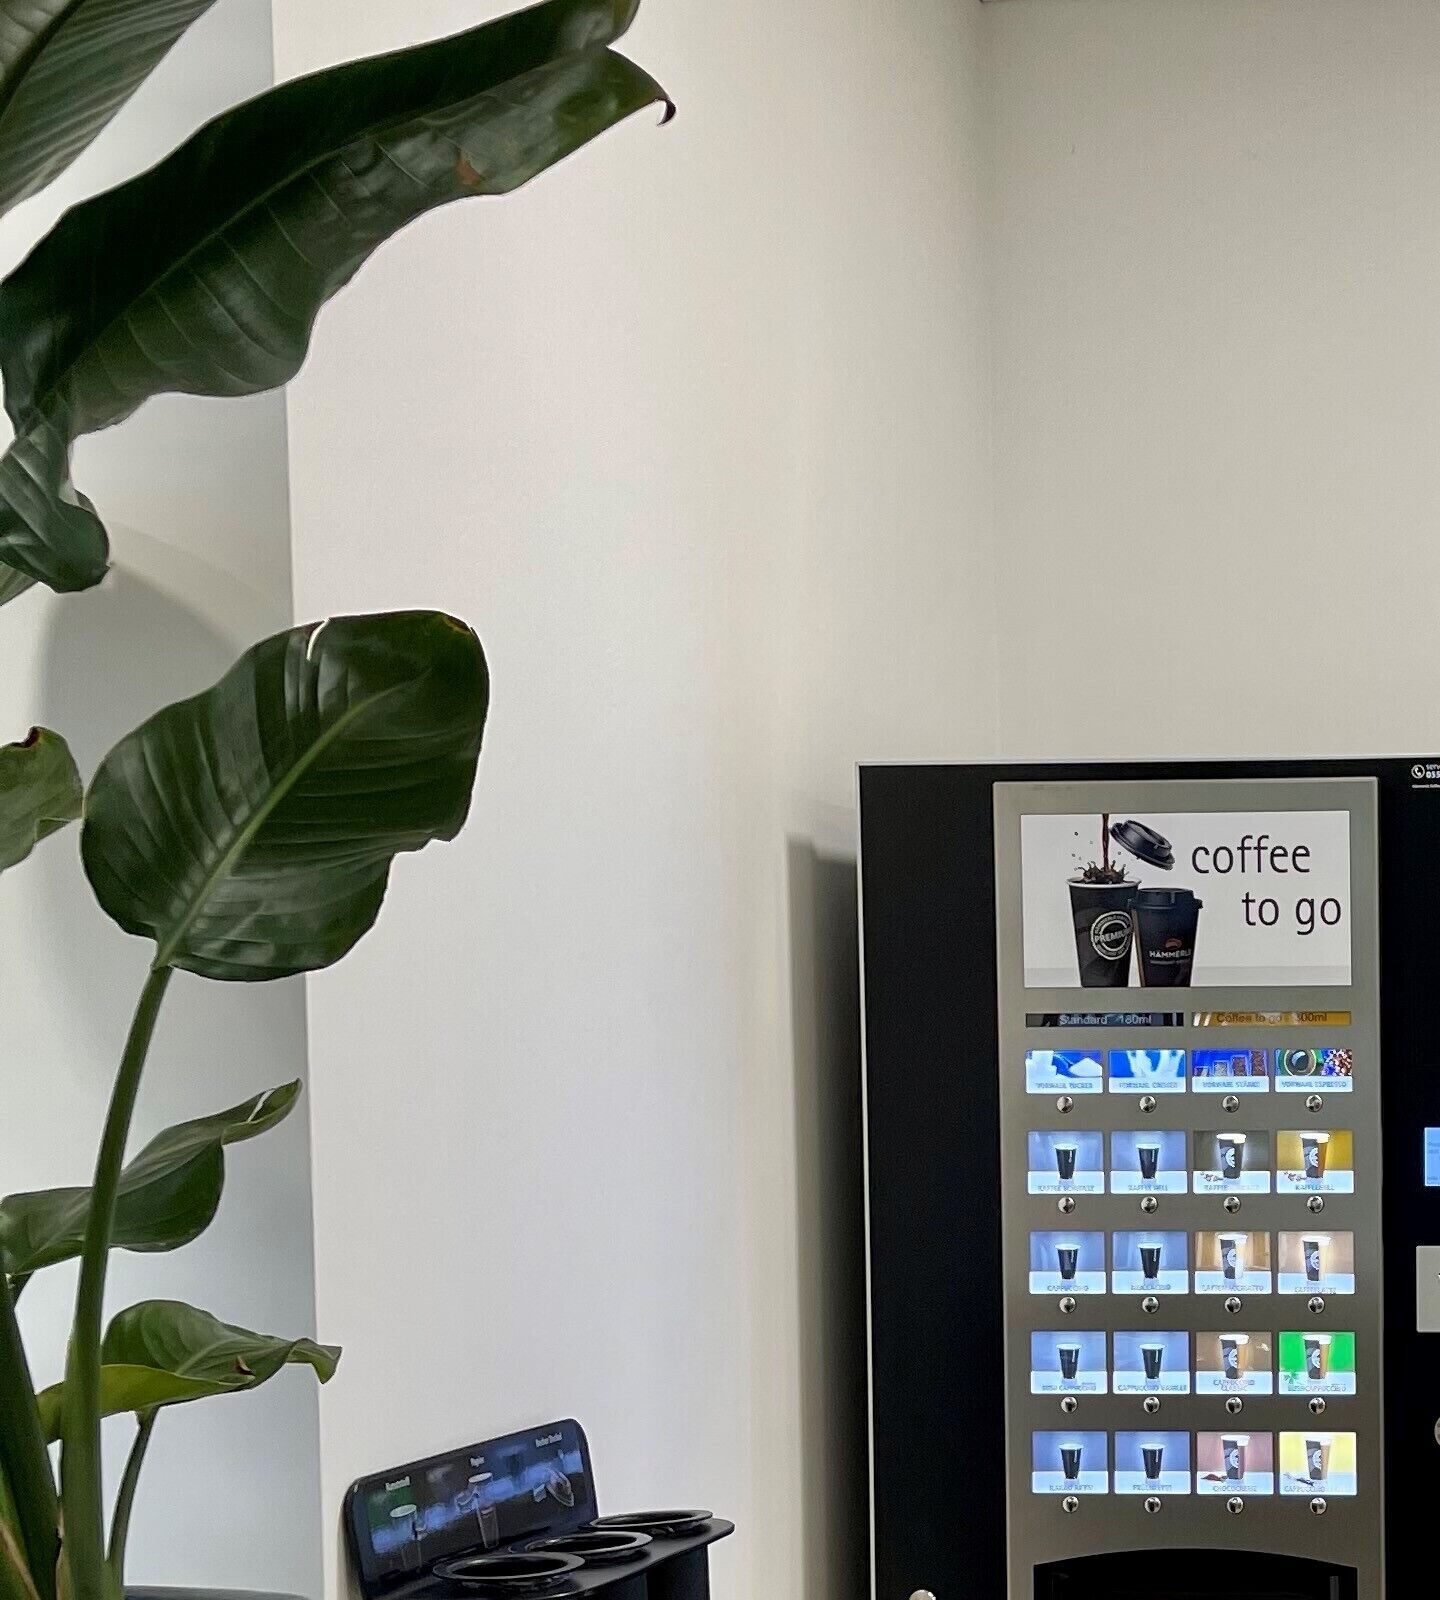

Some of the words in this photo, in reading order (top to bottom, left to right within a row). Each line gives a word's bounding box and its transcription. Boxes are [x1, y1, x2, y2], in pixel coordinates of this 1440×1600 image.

[1191, 834, 1312, 874] coffee
[1242, 891, 1281, 927] to
[1294, 895, 1343, 936] go
